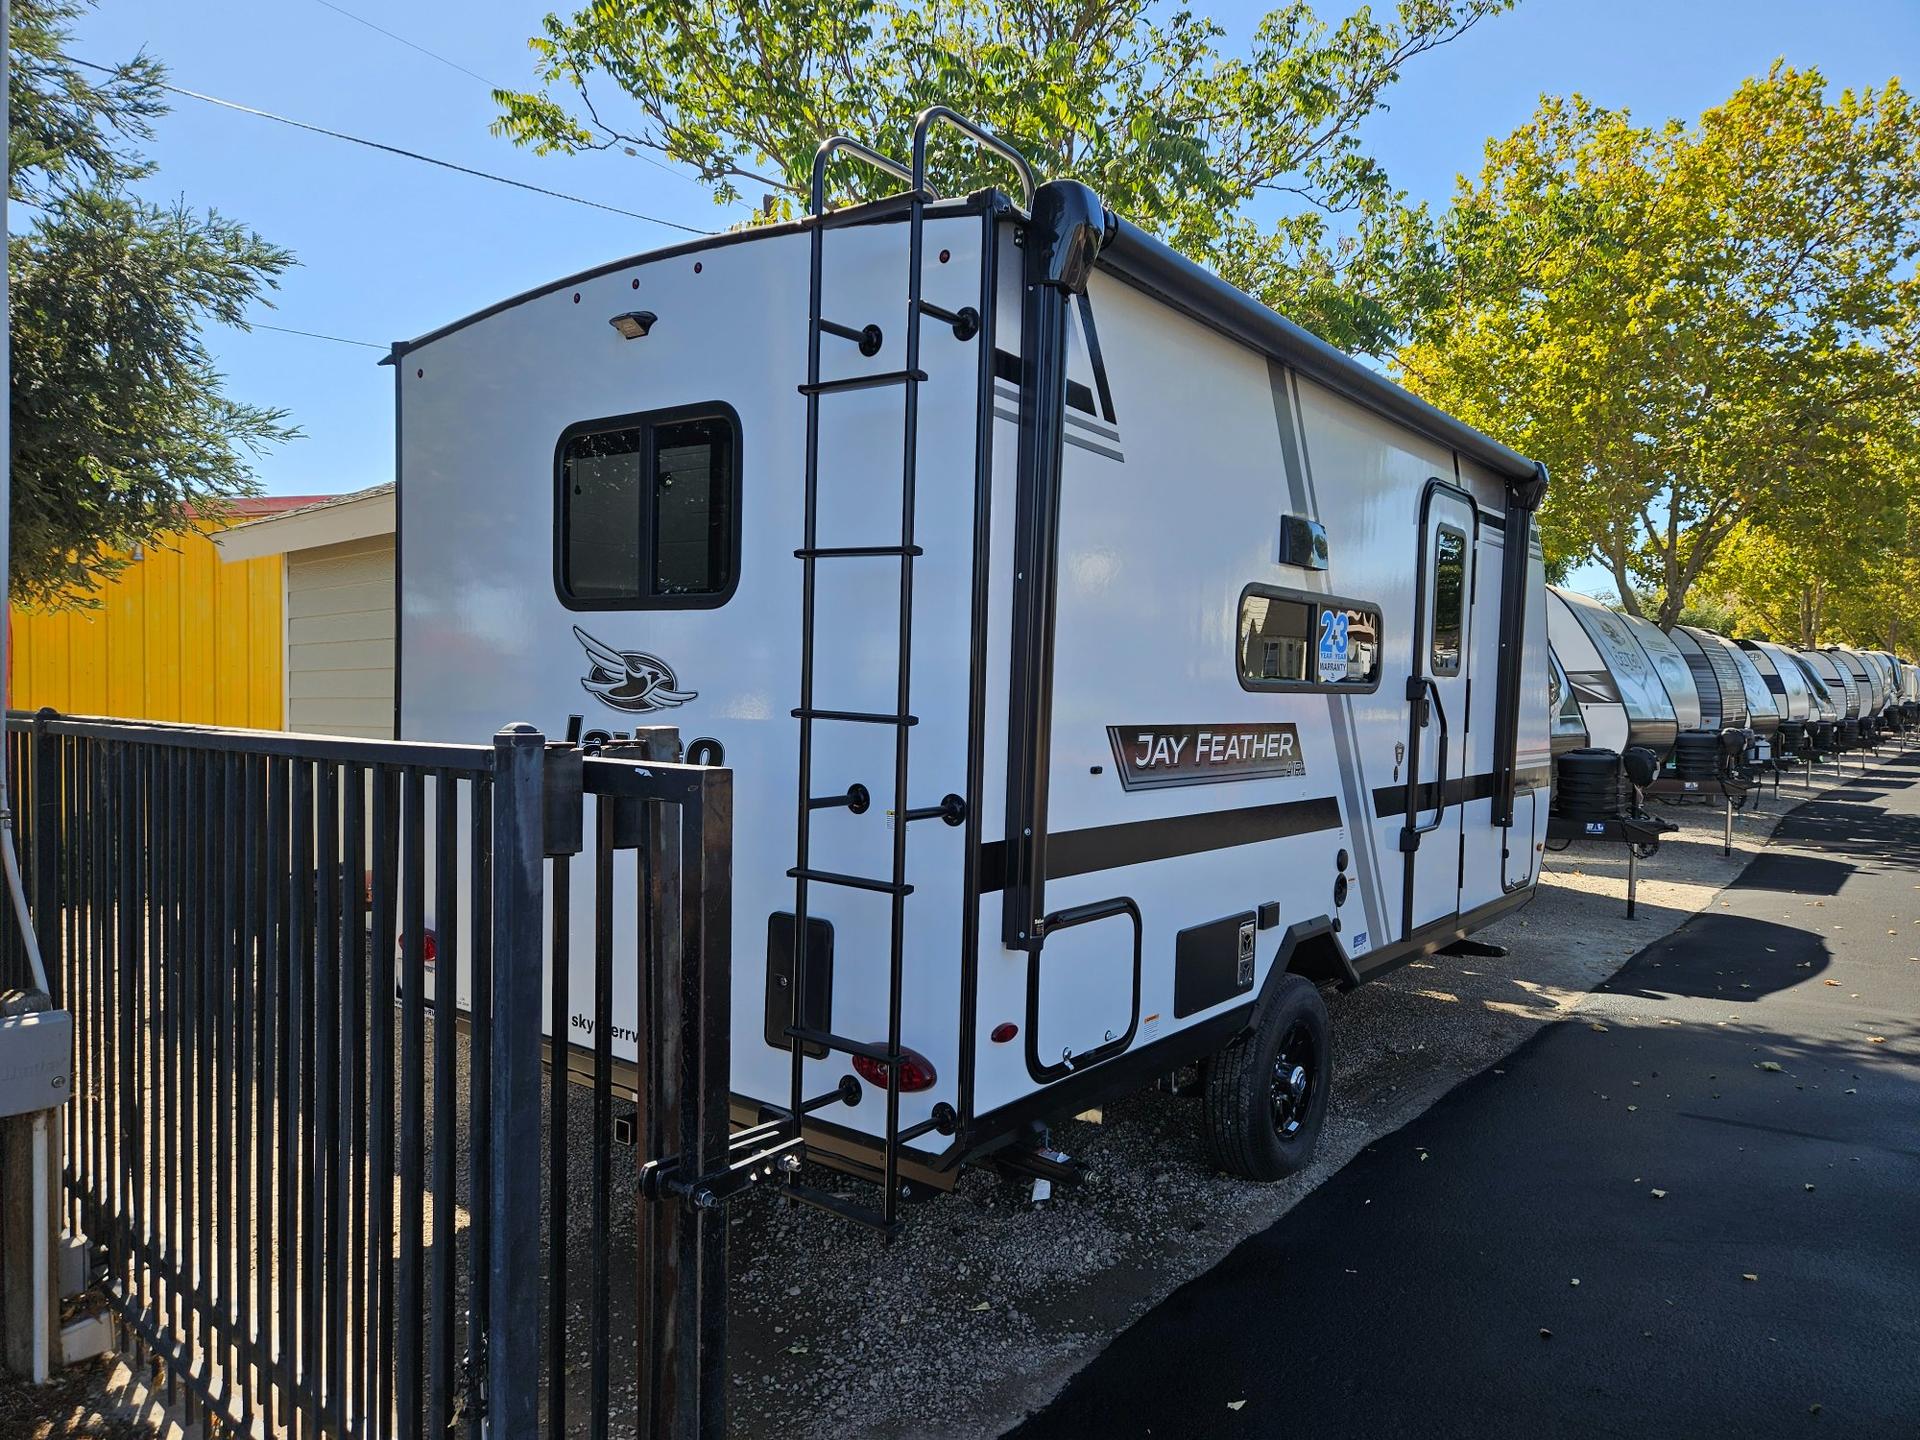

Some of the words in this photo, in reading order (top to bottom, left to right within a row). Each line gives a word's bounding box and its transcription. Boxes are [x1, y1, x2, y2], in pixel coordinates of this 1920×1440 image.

[1319, 662, 1346, 672] WARRANTY
[1135, 734, 1189, 768] JAY
[1194, 731, 1293, 763] FEATHER
